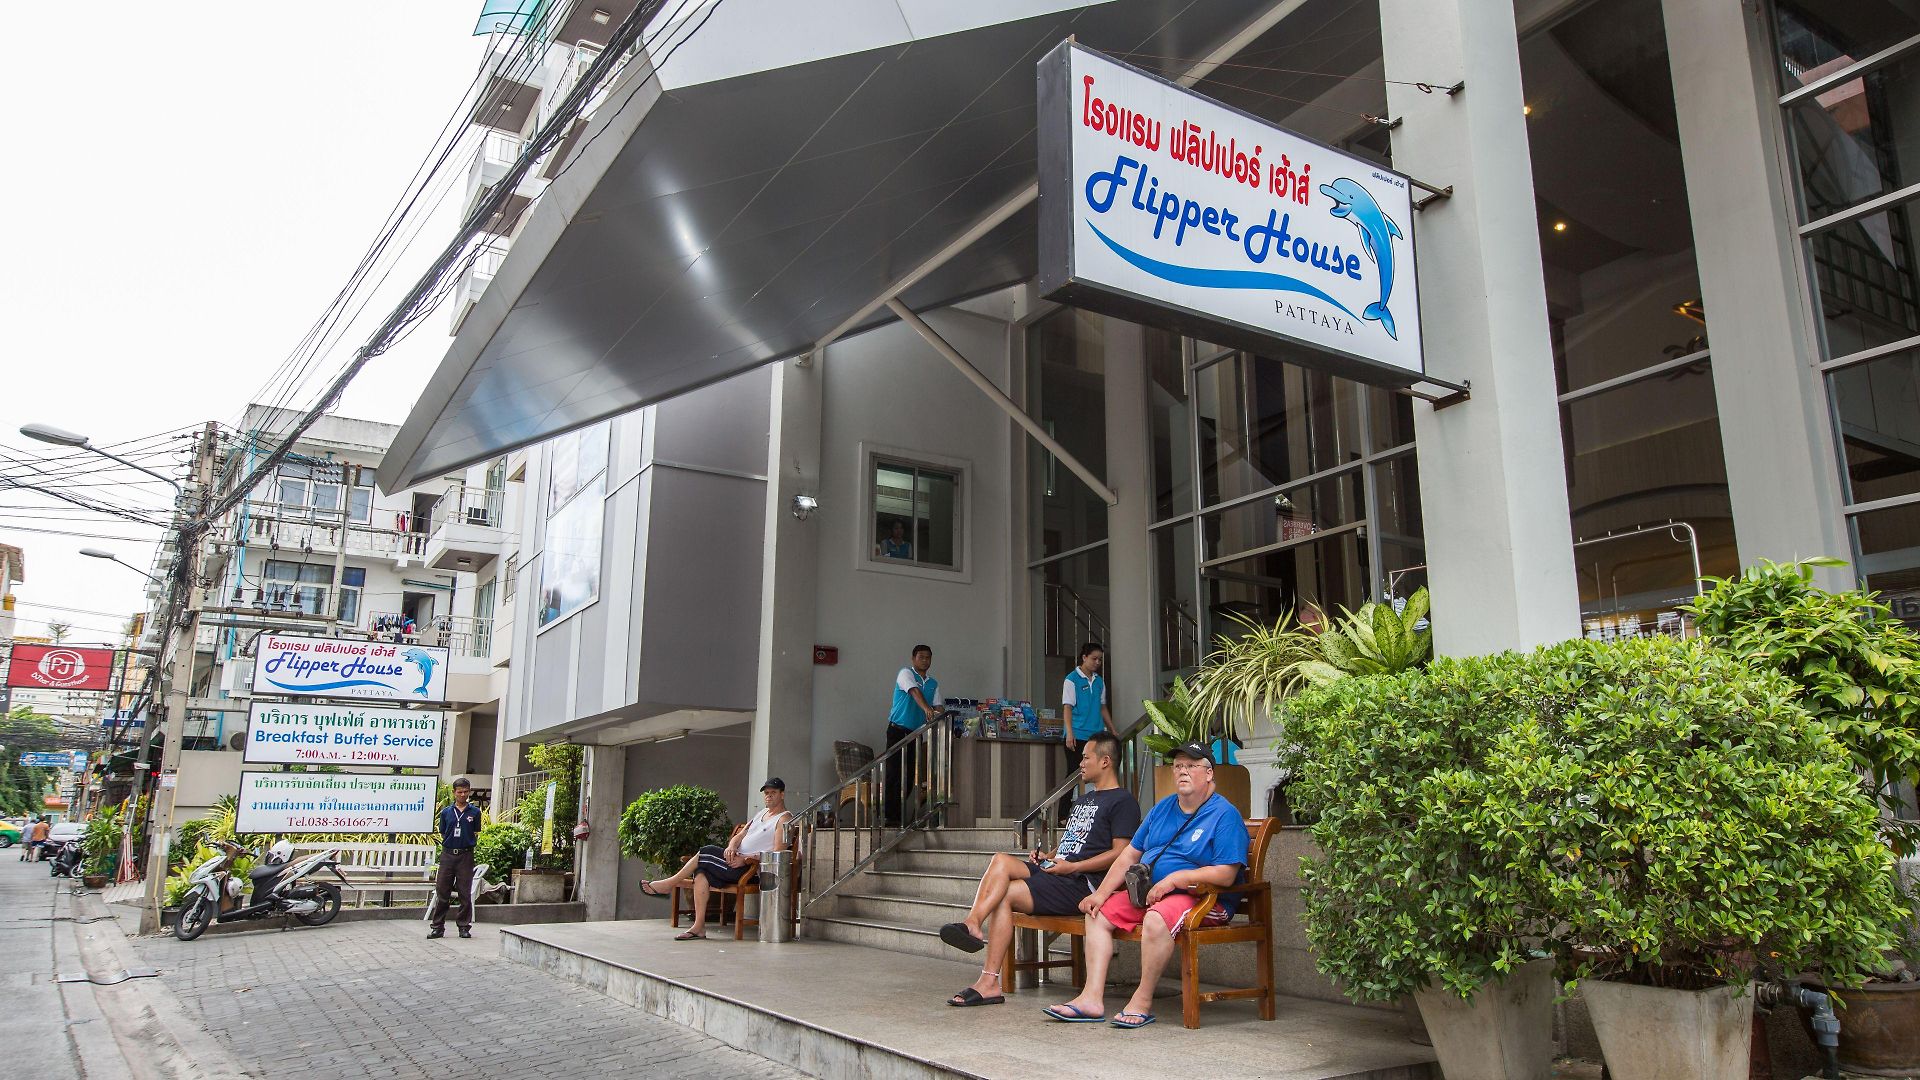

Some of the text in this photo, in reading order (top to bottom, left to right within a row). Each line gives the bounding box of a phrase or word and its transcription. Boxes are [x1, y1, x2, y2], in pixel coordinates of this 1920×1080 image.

[1083, 75, 1311, 206] โรงแรม ฟลิปเปอร์ เฮ้าส์
[1085, 155, 1362, 281] Flipper House
[1275, 299, 1355, 335] PATTAYA
[267, 637, 397, 658] โรงแรม ฟลิปเปอร์ เฮ้าส์
[265, 651, 403, 679] Flipper House
[351, 688, 394, 697] PATTAYA
[260, 709, 436, 731] บริการ บุฟเฟ่ต์ อาหารเช้า
[255, 730, 434, 748] Breakfast Buffet Service
[350, 777, 386, 793] ประชุม
[389, 778, 426, 791] สัมมนา
[251, 798, 315, 811] งานแต่งงาน
[286, 816, 389, 828] Tel.038-361667-71
